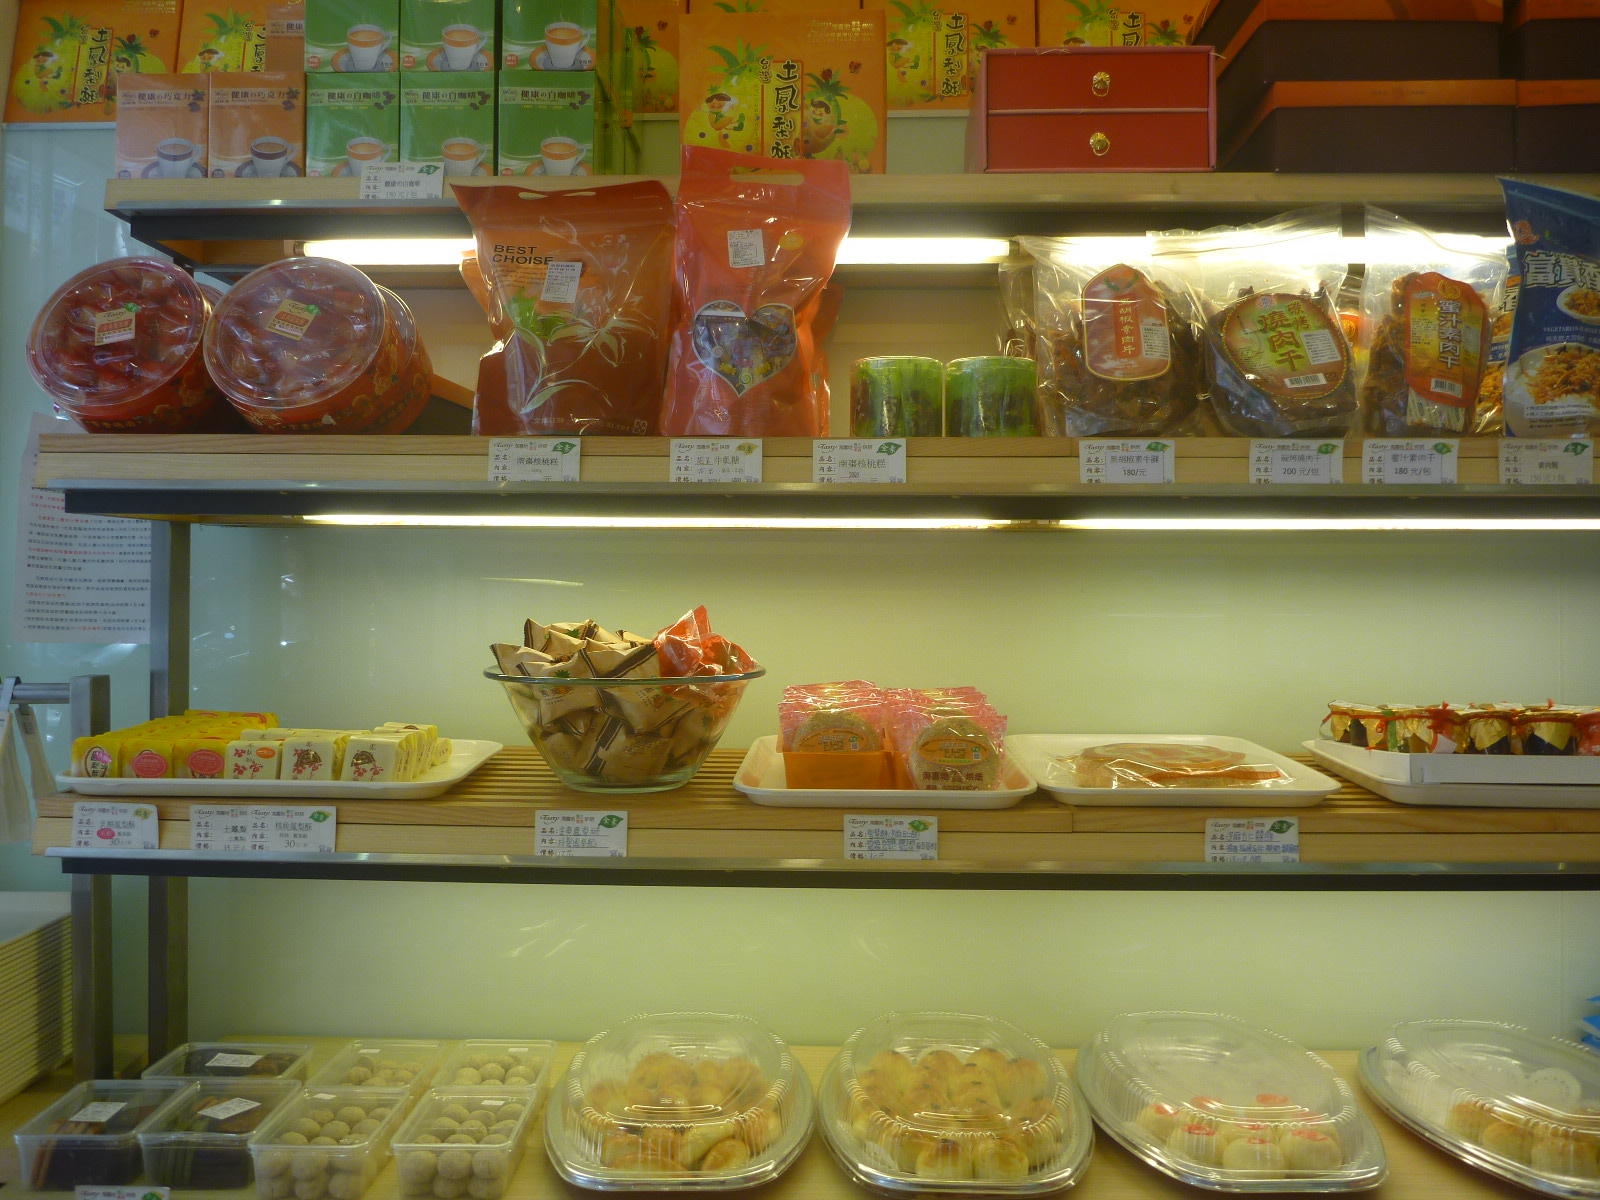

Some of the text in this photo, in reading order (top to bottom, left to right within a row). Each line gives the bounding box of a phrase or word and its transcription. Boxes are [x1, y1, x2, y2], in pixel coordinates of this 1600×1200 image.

[79, 28, 109, 104] 土鳳梨酥
[941, 13, 965, 96] 土鳳梨酥
[492, 254, 553, 265] CHOISE
[494, 244, 537, 254] BEST
[1258, 310, 1305, 371] 燒肉干
[1439, 300, 1461, 368] 蜜汁素肉干
[285, 839, 296, 848] 30
